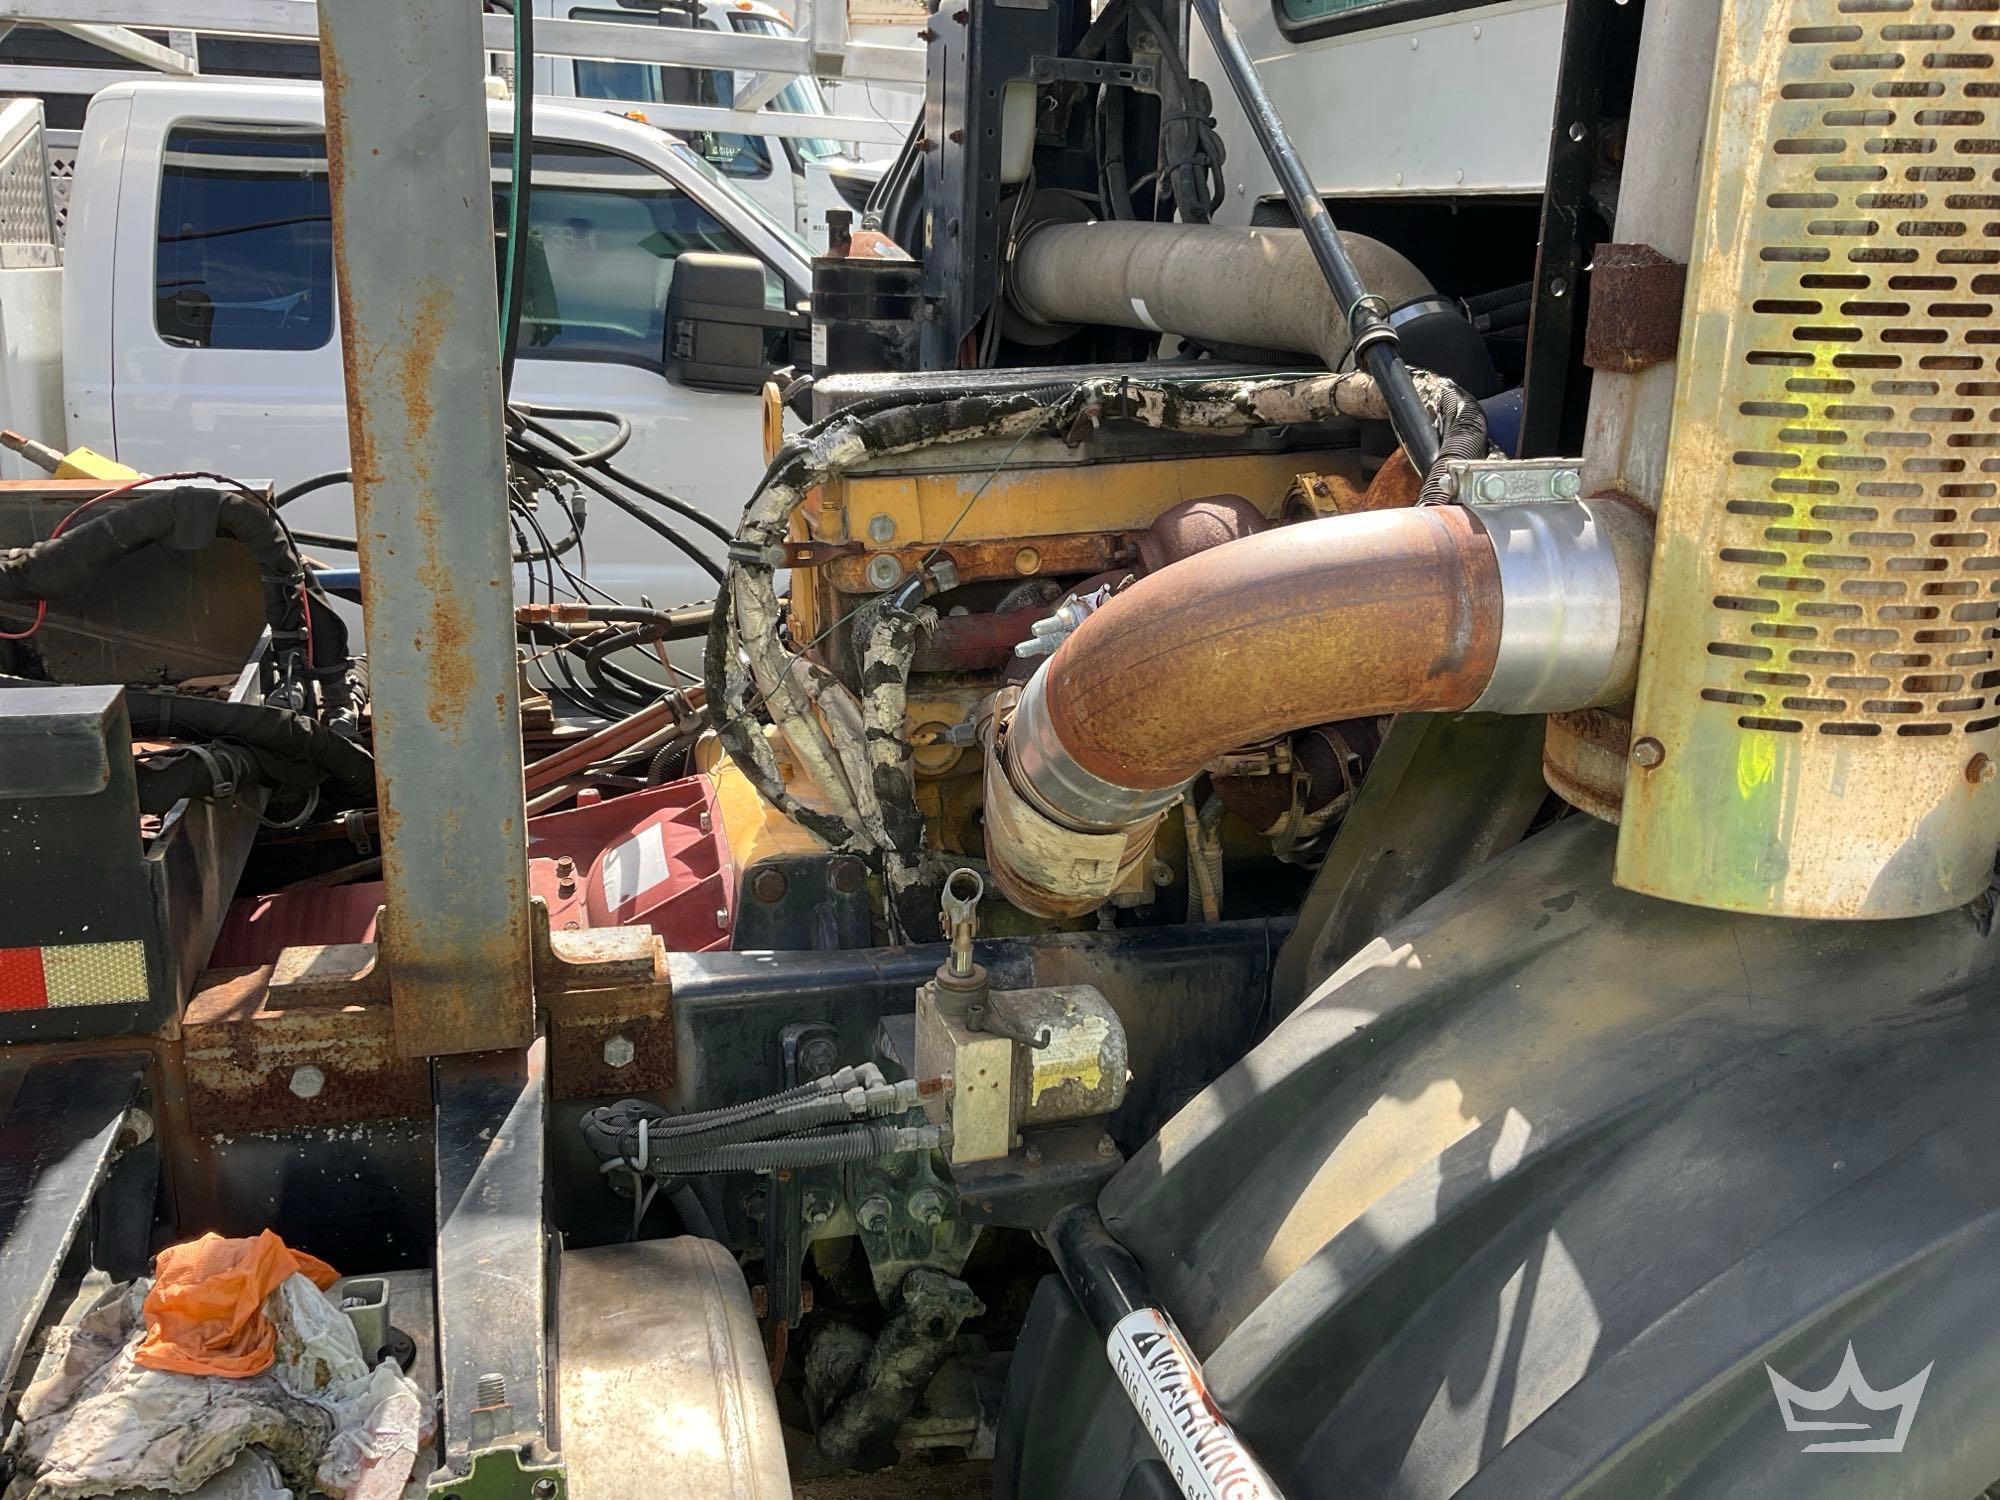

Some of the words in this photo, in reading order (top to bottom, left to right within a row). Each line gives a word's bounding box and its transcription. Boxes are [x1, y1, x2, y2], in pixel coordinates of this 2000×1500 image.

[1117, 1348, 1139, 1403] This
[1141, 1395, 1151, 1427] is
[1154, 1424, 1175, 1466] not
[1175, 1465, 1185, 1485] a
[1147, 1348, 1257, 1500] WARNING
